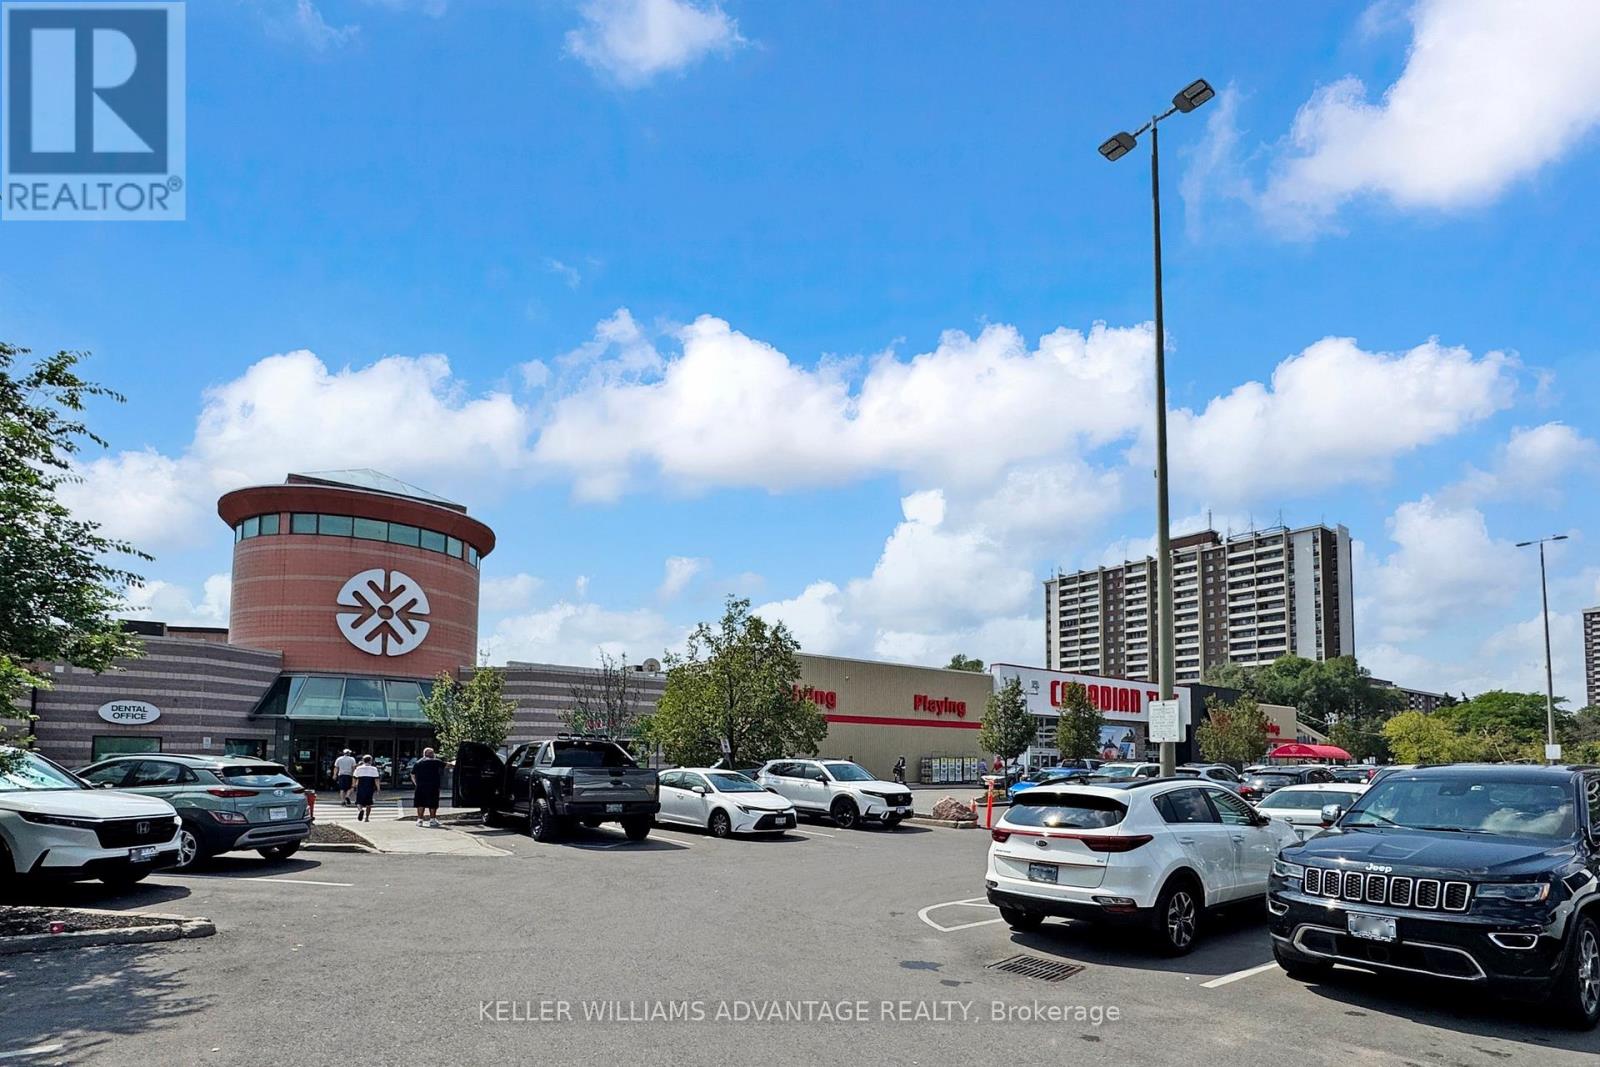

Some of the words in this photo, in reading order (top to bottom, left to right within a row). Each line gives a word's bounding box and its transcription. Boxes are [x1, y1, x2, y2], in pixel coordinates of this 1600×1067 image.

[779, 684, 837, 710] iving
[913, 694, 967, 718] Playing
[1365, 863, 1393, 873] Jeep
